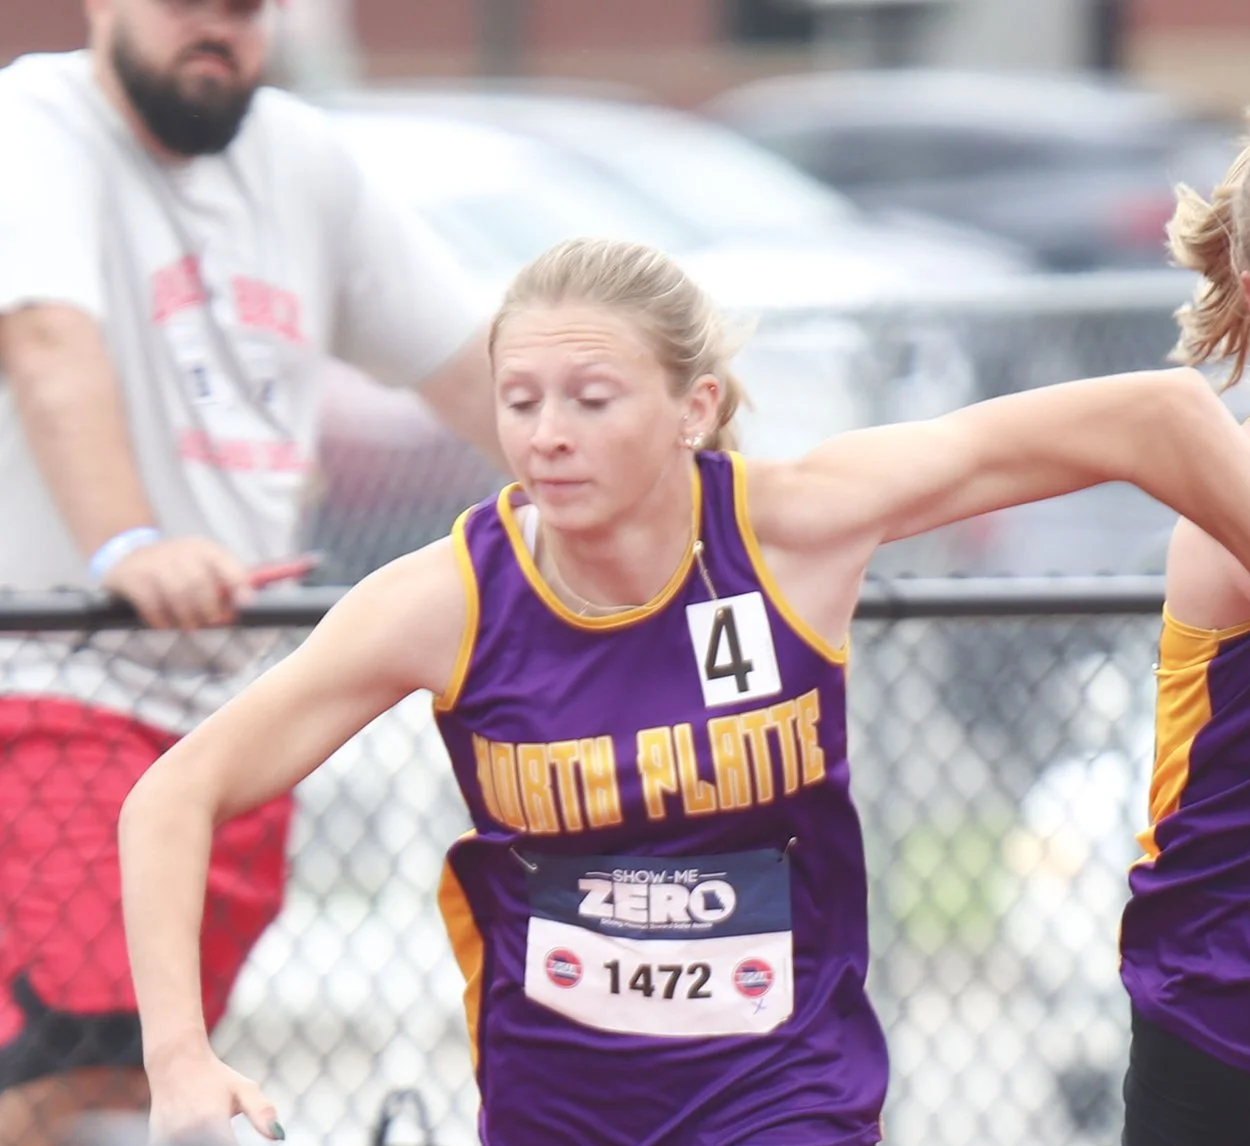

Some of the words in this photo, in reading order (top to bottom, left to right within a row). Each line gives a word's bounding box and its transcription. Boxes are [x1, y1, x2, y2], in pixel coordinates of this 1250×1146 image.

[704, 604, 754, 693] 4
[636, 687, 827, 820] PLATTE
[611, 868, 700, 884] SHOW-ME
[577, 877, 737, 925] ZERO
[603, 958, 713, 1000] 1472
